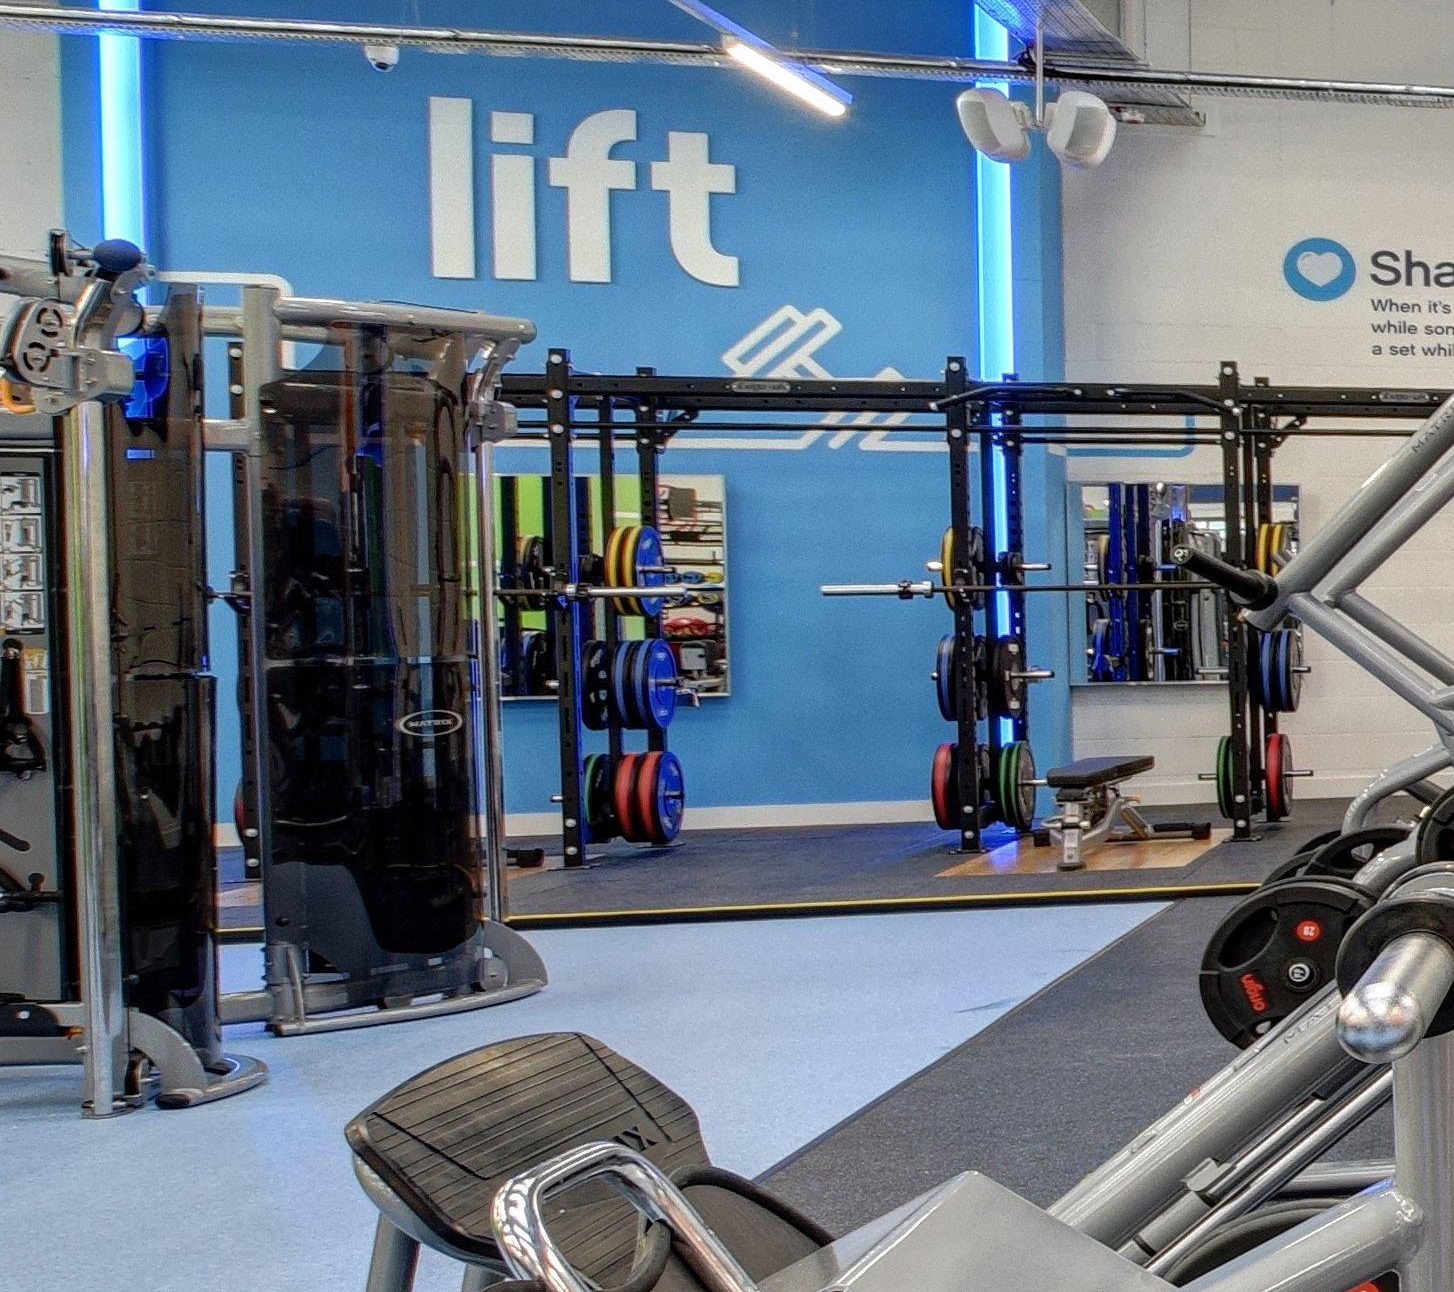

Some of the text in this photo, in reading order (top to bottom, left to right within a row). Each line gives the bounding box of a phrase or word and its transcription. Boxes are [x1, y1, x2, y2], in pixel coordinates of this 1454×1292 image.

[427, 96, 740, 288] lift
[1370, 299, 1422, 314] When
[1371, 321, 1418, 335] while
[1371, 346, 1382, 356] a
[1389, 345, 1417, 356] set
[406, 717, 455, 729] MATRIX
[1240, 974, 1267, 1012] origin
